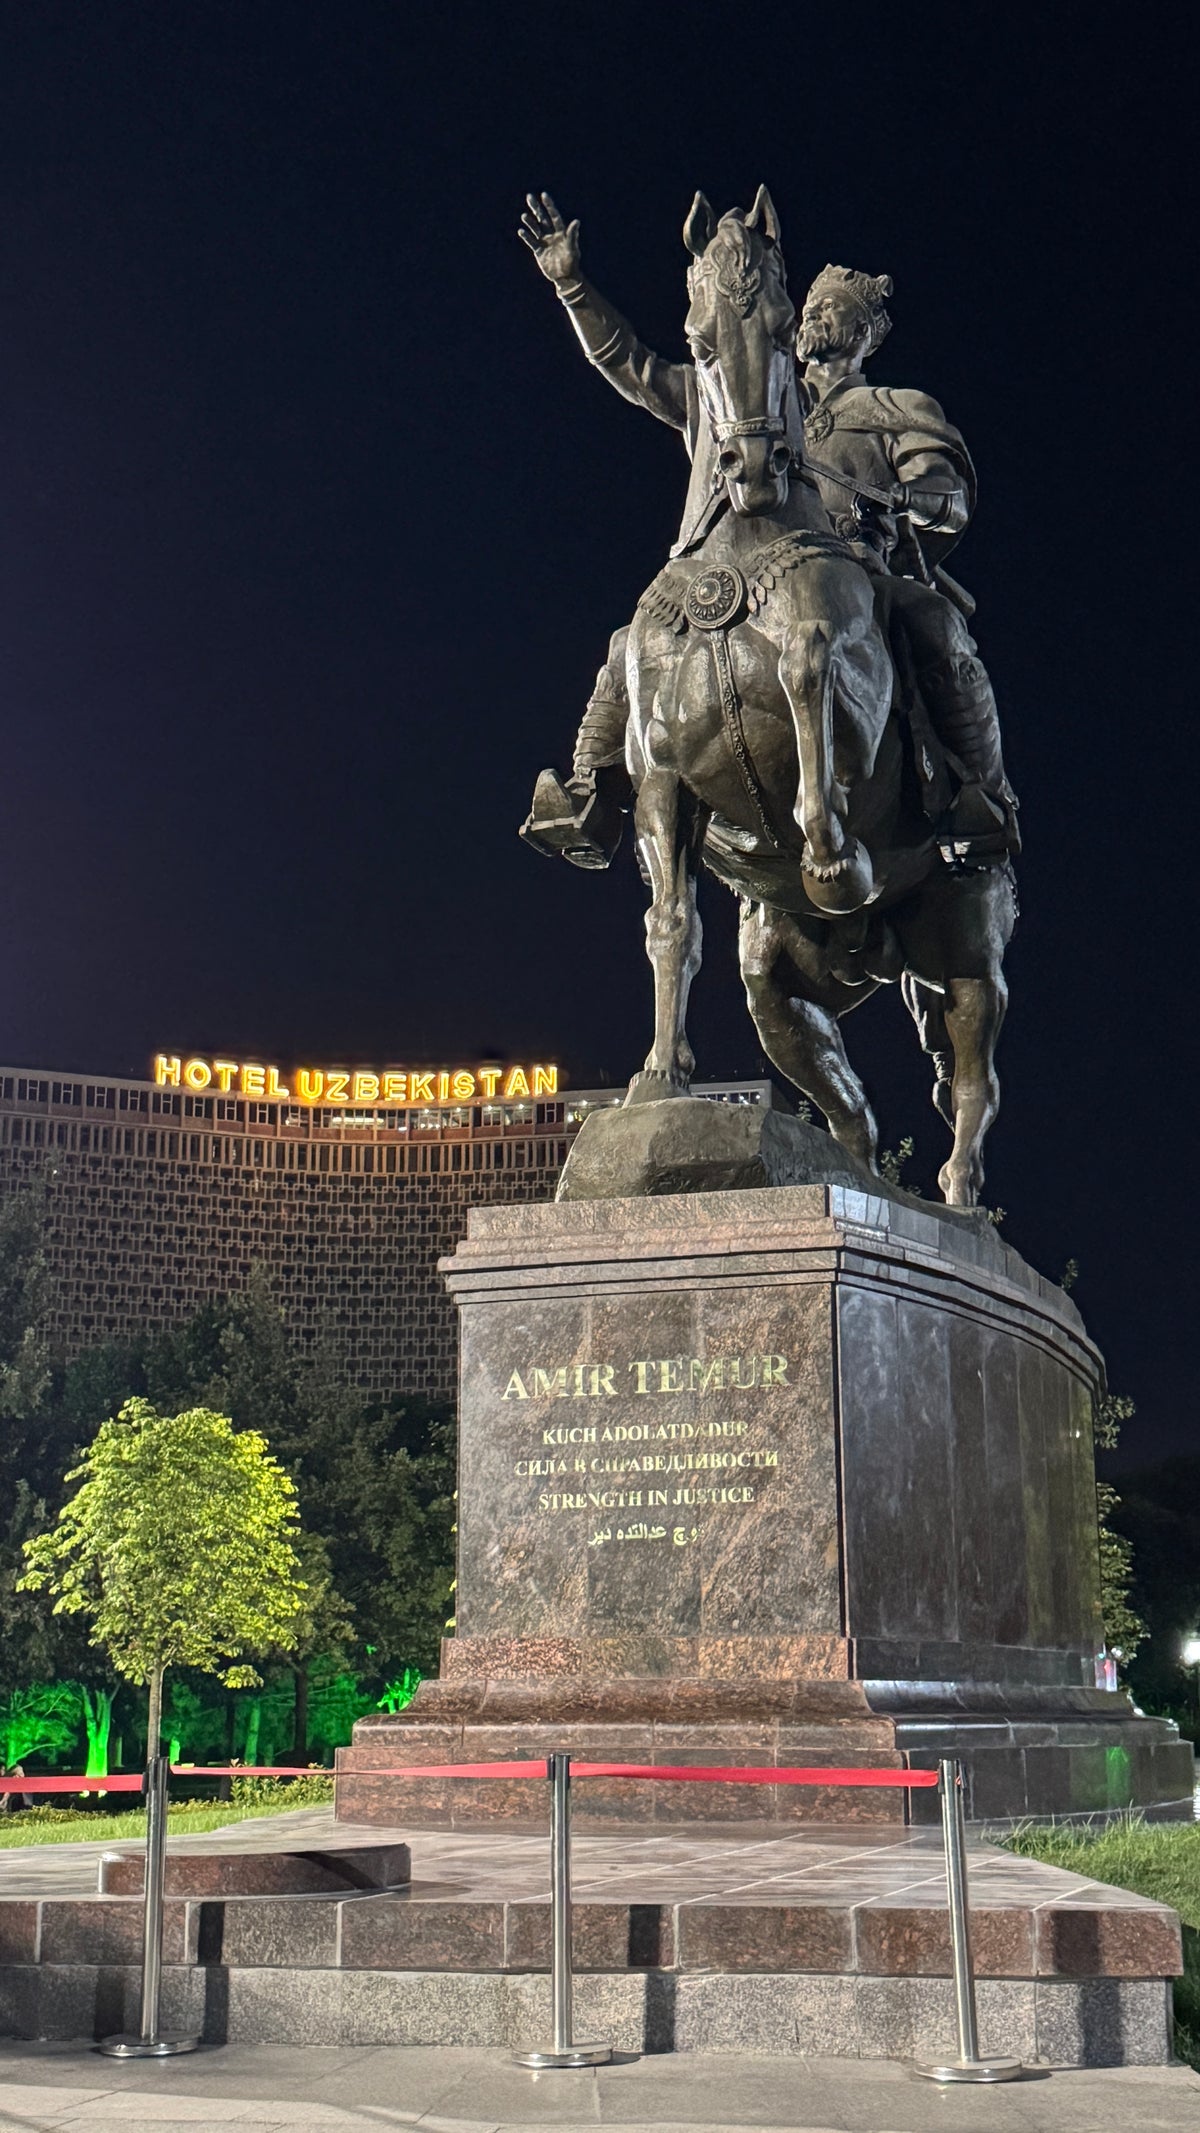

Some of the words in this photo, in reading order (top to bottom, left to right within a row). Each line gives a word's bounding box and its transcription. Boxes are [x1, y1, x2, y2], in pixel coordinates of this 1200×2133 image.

[156, 1053, 290, 1098] HOTEL
[298, 1066, 559, 1102] UZBEKISTAN
[501, 1363, 618, 1400] AMIR
[628, 1354, 792, 1394] TEMUR
[542, 1428, 597, 1445] KUCH
[515, 1460, 567, 1476] СИЛА
[538, 1491, 642, 1511] STRENGTH
[649, 1490, 668, 1506] IN
[672, 1486, 755, 1505] JUSTICE
